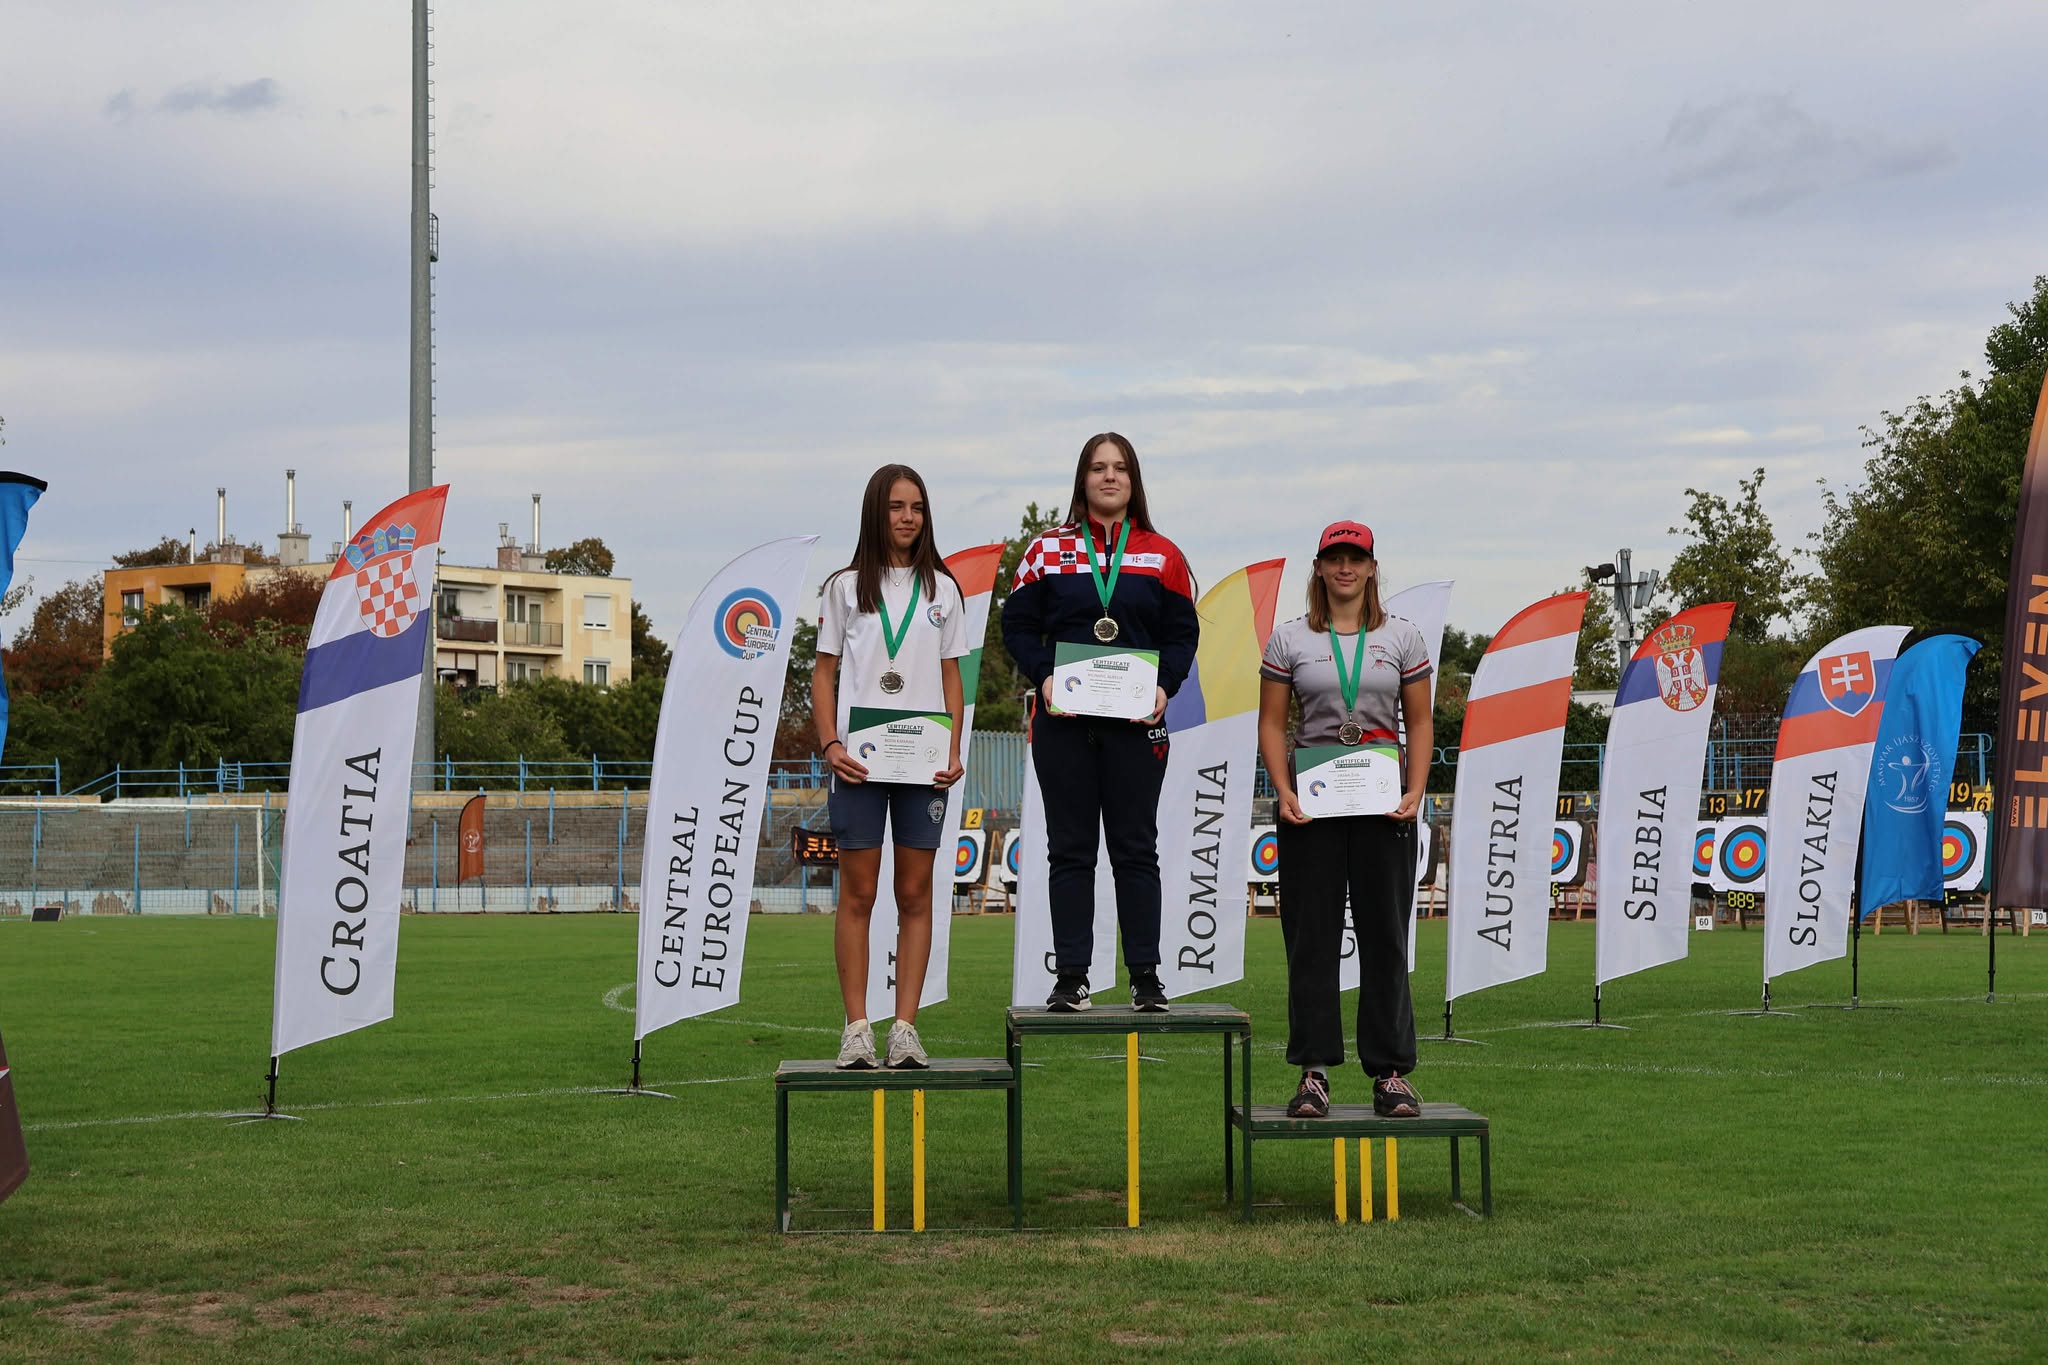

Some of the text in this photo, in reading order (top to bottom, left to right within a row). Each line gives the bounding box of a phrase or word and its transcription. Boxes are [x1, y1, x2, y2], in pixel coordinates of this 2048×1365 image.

[1328, 529, 1361, 540] HOYT
[746, 624, 774, 639] CENTRAL
[744, 637, 776, 652] EUROPEAN
[741, 649, 755, 660] CUP
[1092, 659, 1130, 667] CERTIFICATE
[886, 723, 924, 731] CERTIFICATE
[1148, 728, 1167, 740] CRO
[1878, 744, 1893, 786] MAGYAR
[1745, 789, 1765, 808] 17
[1950, 782, 1970, 803] 19
[1558, 798, 1572, 815] 11
[1709, 797, 1725, 814] 13
[970, 811, 978, 824] 2
[691, 685, 763, 992] EUROPEAN CUP
[1624, 785, 1667, 921] SERBIA
[1789, 771, 1838, 946] SLOVAKIA
[320, 747, 381, 996] CROATIA
[1178, 761, 1228, 974] ROMANIA
[1477, 775, 1523, 951] AUSTRIA
[654, 806, 699, 988] CENTRAL
[1727, 891, 1755, 909] 889
[1699, 917, 1709, 926] 60
[2034, 912, 2044, 921] 70
